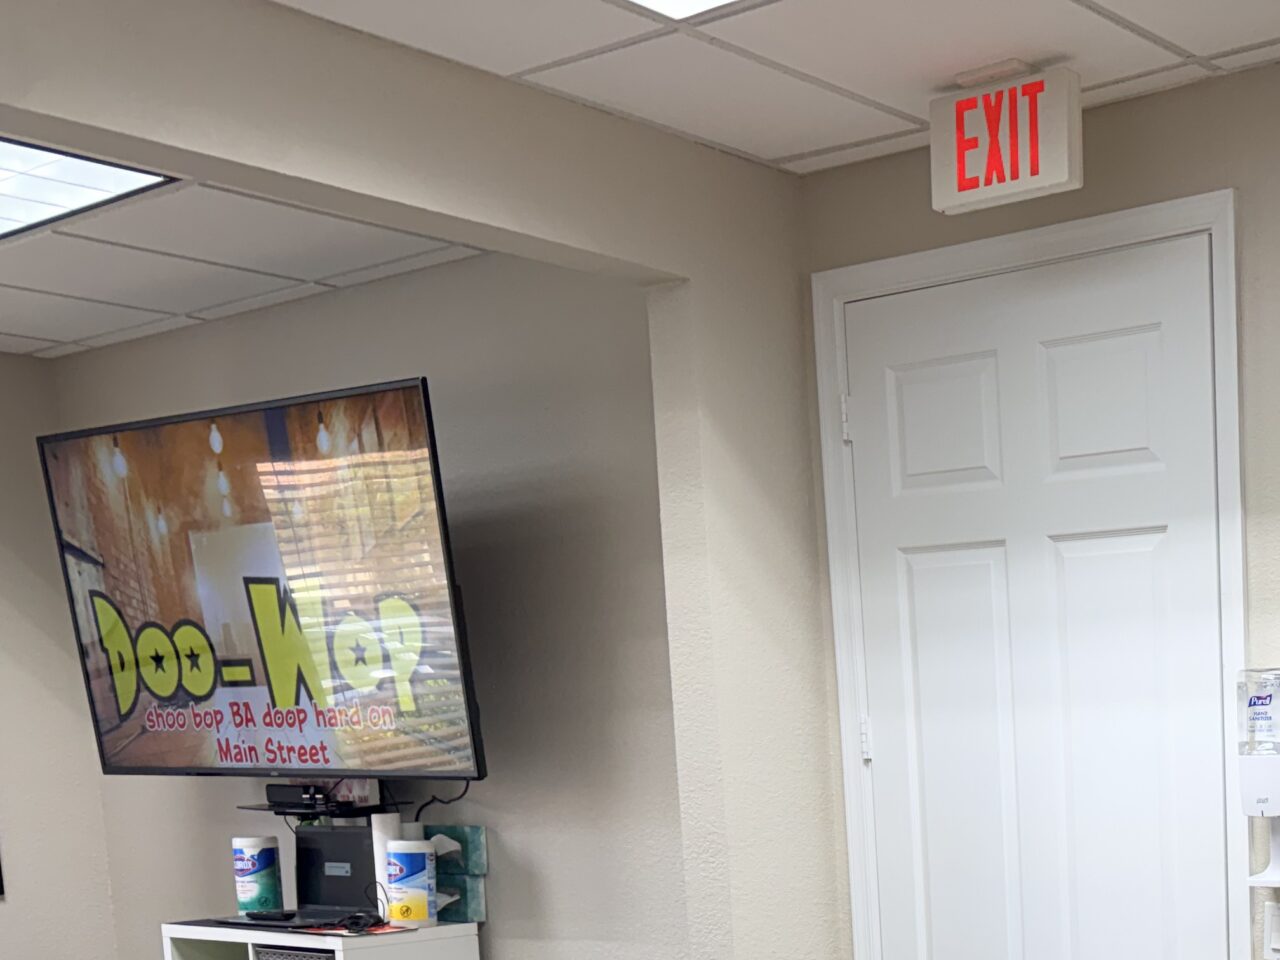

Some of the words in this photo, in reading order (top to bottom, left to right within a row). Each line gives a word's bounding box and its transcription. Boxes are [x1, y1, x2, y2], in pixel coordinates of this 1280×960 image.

[956, 80, 1045, 192] EXIT
[146, 702, 187, 730] shoo
[190, 701, 224, 734] bop
[228, 701, 257, 729] BA
[262, 702, 308, 733] doop
[312, 699, 363, 729] hard
[368, 705, 395, 729] on
[217, 736, 260, 763] Main
[265, 736, 331, 765] Street
